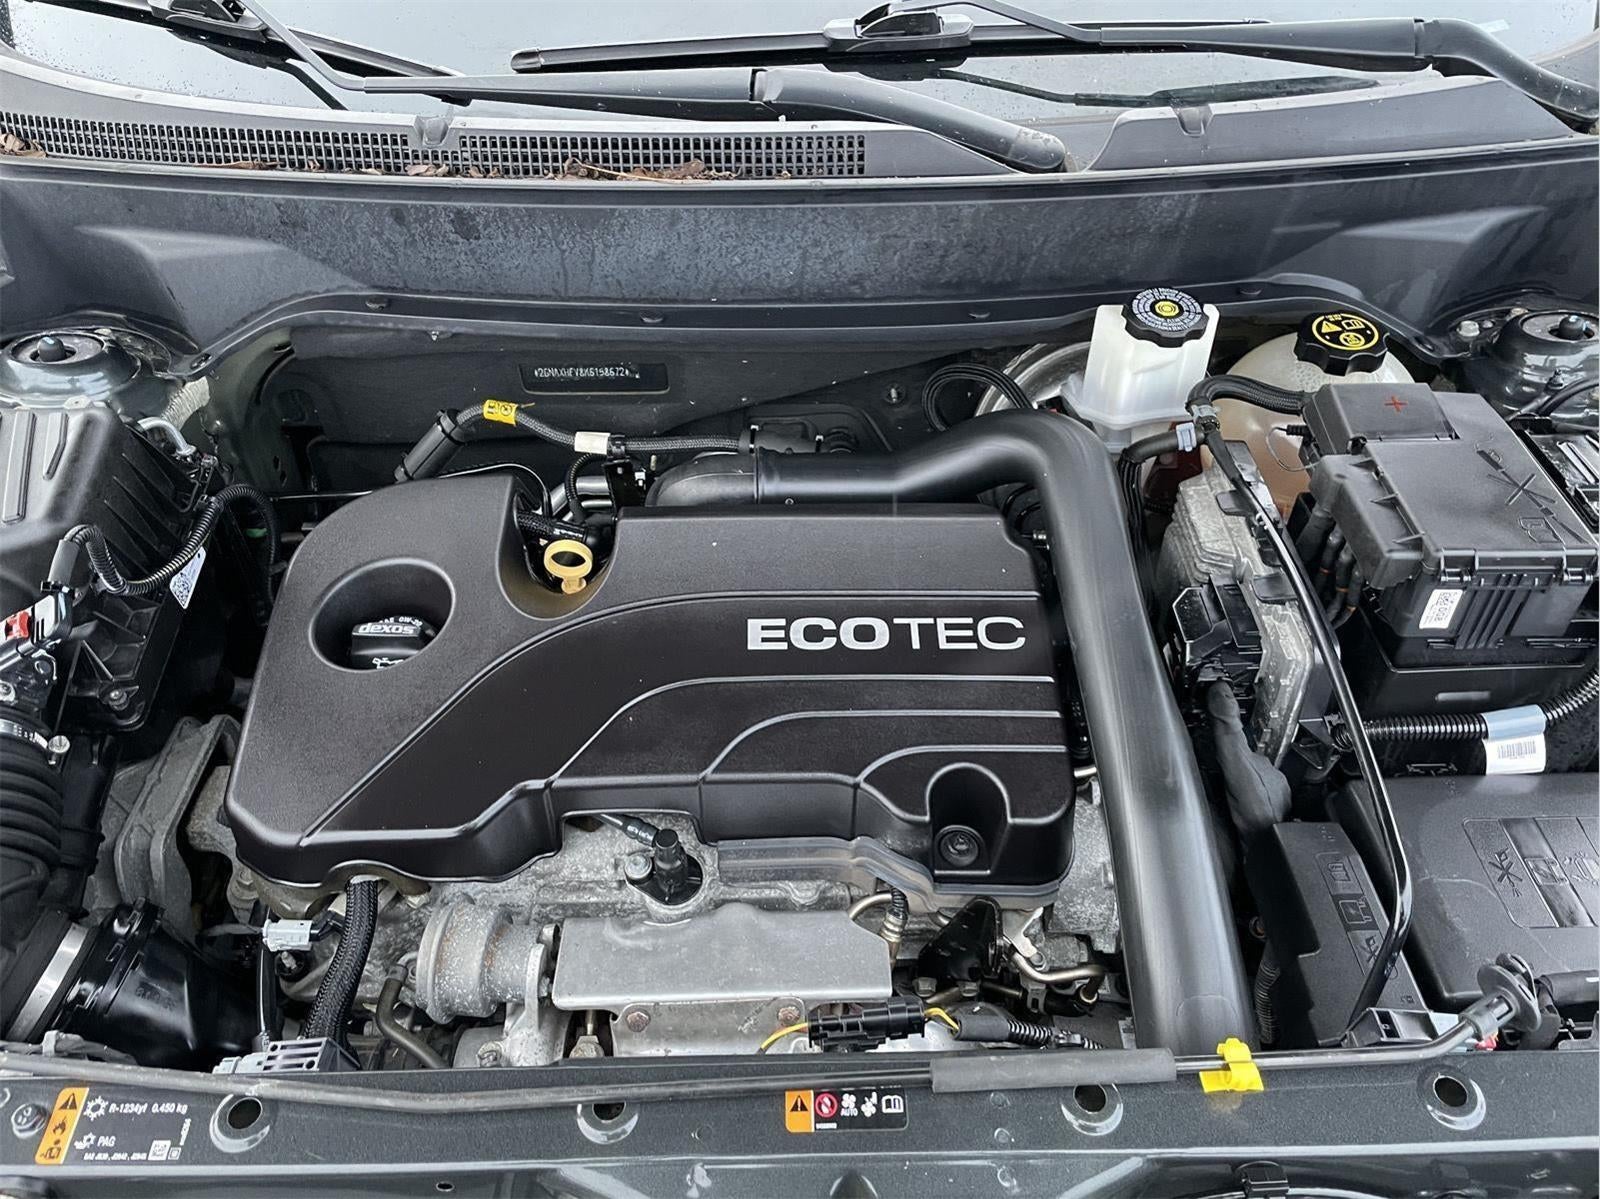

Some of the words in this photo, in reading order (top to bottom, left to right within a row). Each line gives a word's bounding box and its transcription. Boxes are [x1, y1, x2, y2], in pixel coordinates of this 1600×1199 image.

[358, 623, 417, 634] dexos
[747, 616, 1026, 650] ECOTEC
[151, 1102, 176, 1113] 0.450
[176, 1102, 188, 1115] kg
[840, 1108, 858, 1116] AUTO
[97, 1135, 116, 1147] PAG
